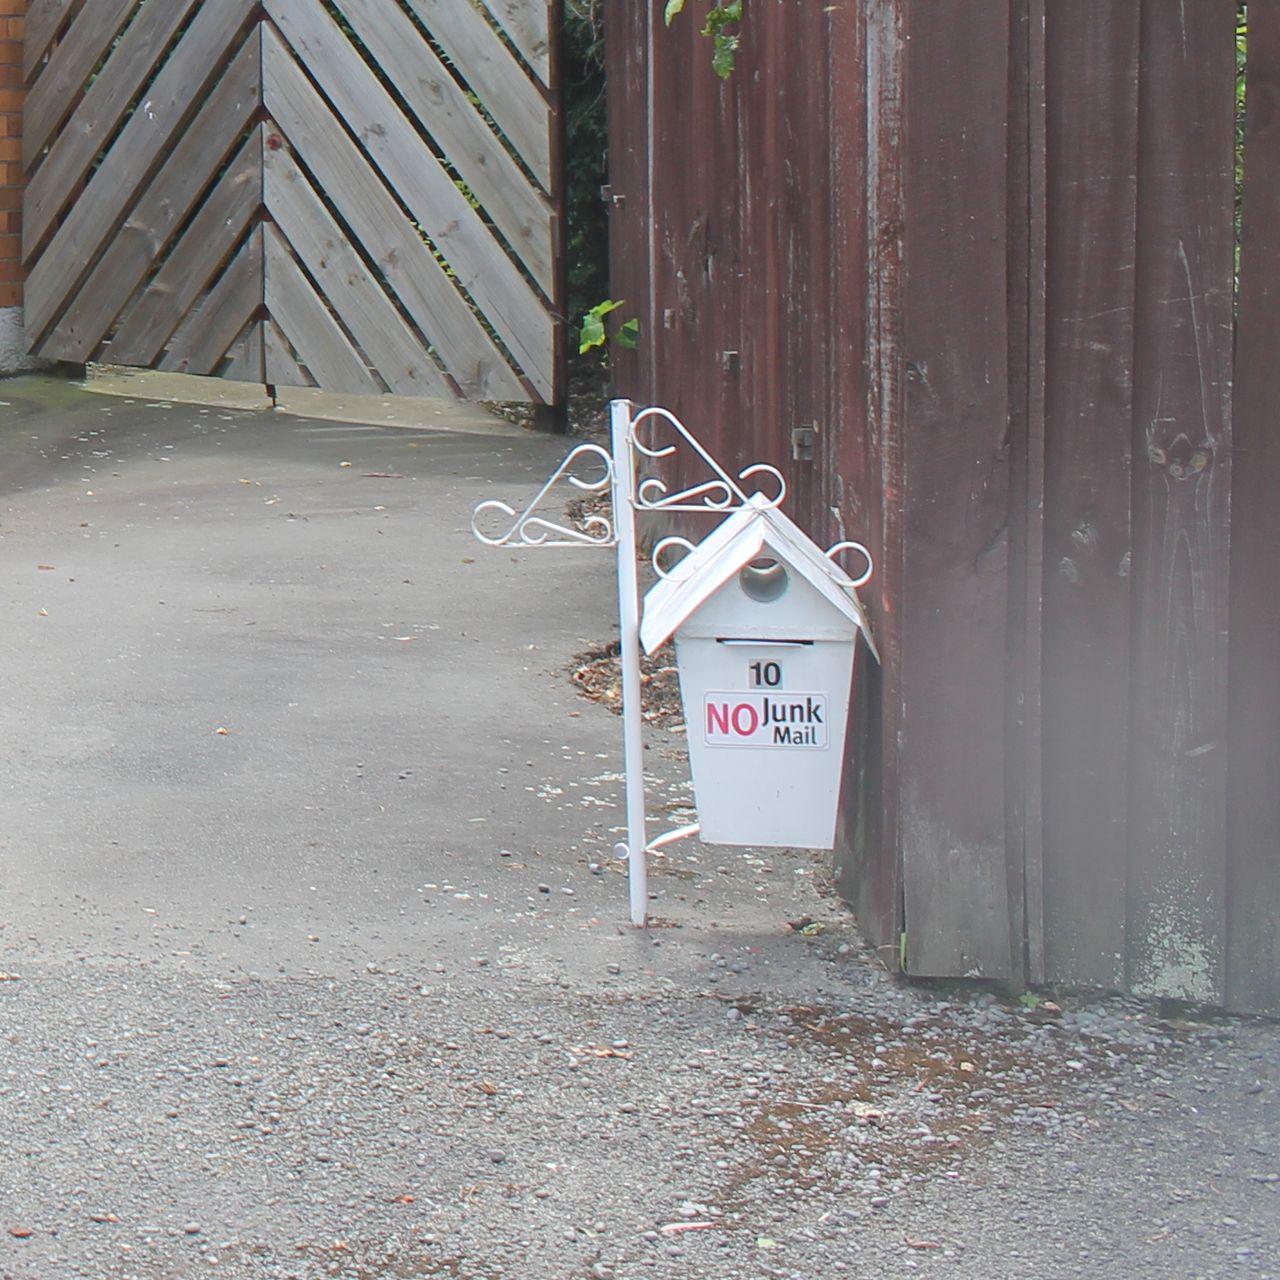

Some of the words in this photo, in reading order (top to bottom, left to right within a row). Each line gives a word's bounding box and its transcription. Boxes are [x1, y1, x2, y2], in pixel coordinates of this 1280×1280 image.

[750, 661, 781, 686] 10
[706, 702, 759, 736] NO
[761, 696, 823, 727] Junk
[773, 726, 817, 745] Mail
